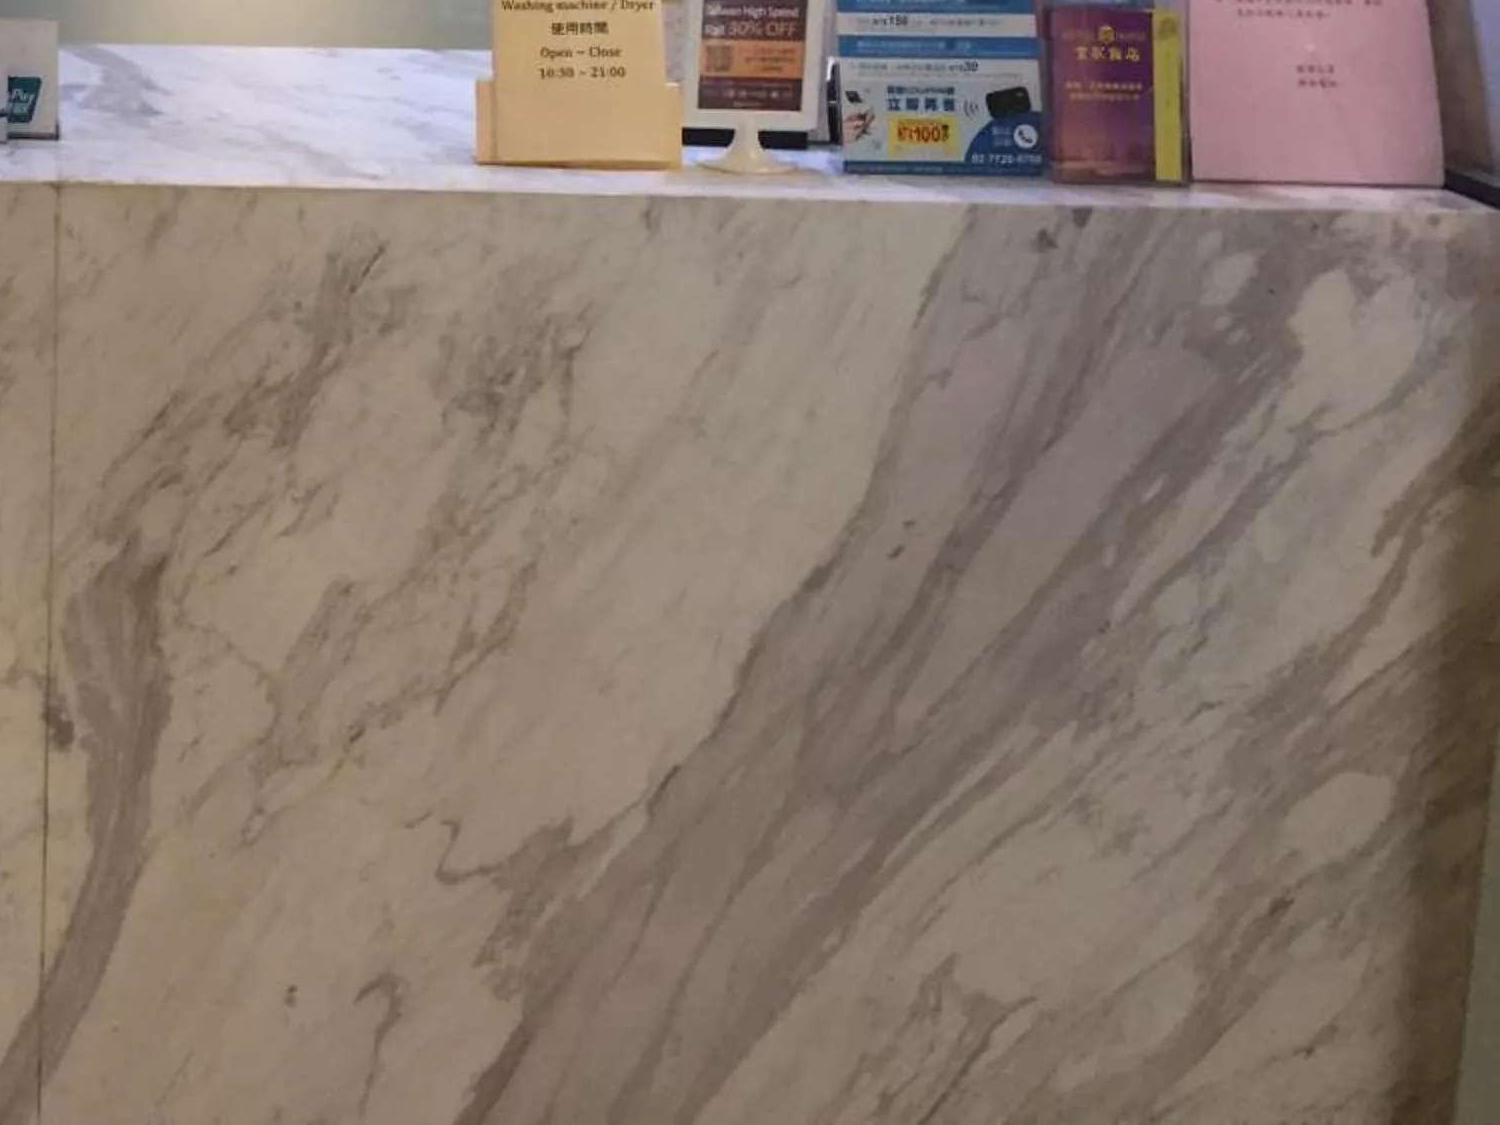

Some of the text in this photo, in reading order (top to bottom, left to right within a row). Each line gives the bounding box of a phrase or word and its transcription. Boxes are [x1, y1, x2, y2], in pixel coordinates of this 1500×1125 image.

[501, 0, 553, 13] Washing
[556, 0, 608, 10] machine
[621, 0, 654, 12] Dryer
[767, 23, 797, 37] OFF
[540, 47, 573, 59] Open
[589, 46, 622, 58] Close
[590, 66, 627, 79] 21:00
